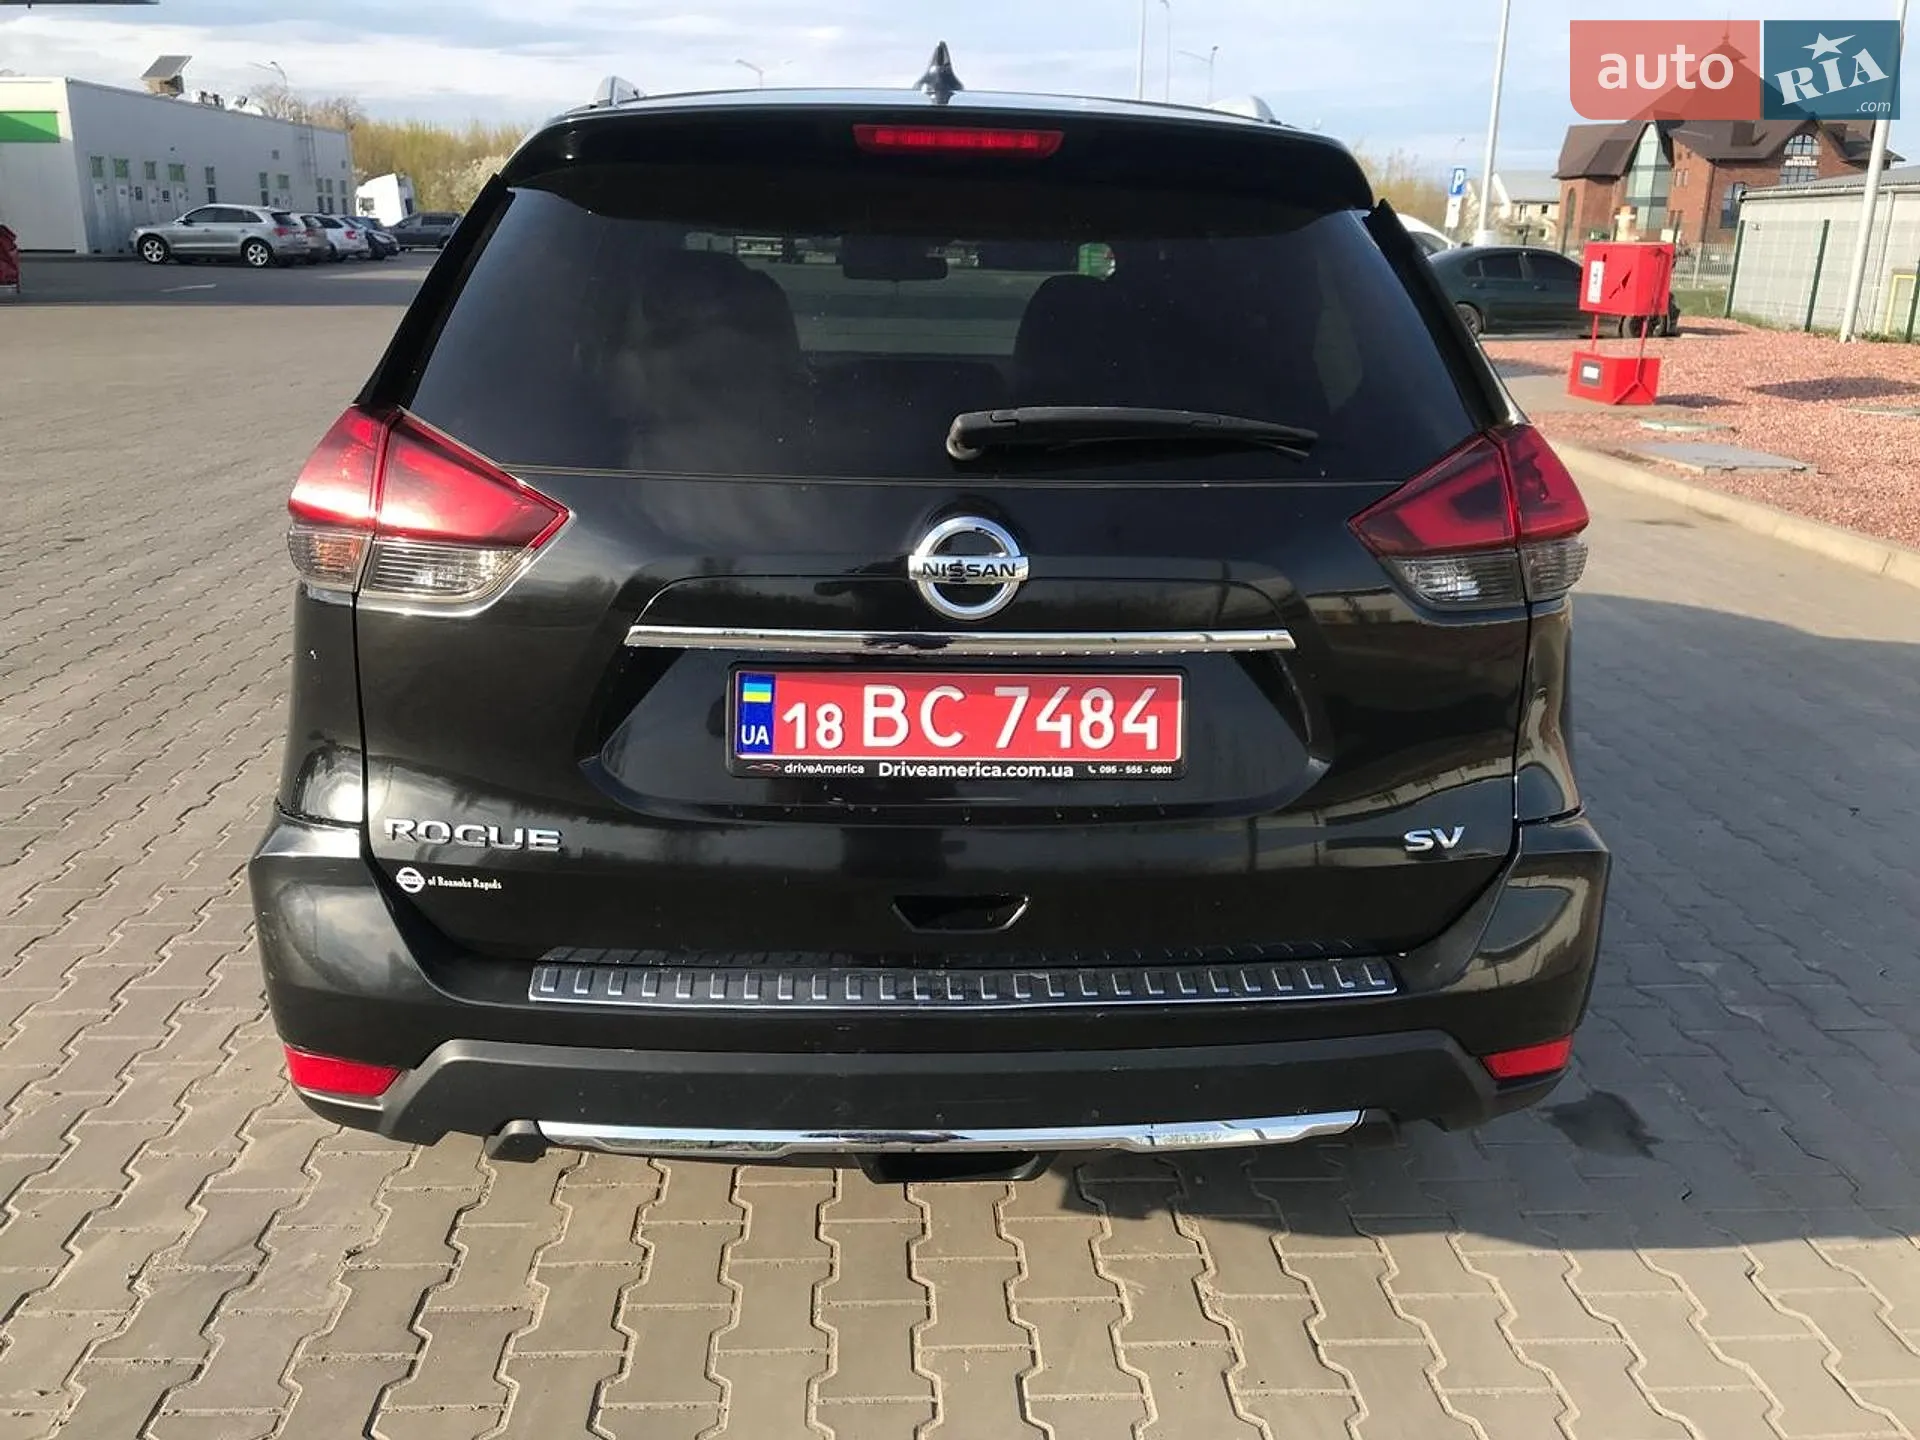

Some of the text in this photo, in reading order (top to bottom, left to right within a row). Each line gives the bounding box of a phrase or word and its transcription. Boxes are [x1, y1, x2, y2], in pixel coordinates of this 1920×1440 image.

[921, 561, 1017, 578] NISSAN
[782, 684, 1158, 751] 18 BC 7484
[741, 724, 770, 746] UA
[784, 762, 865, 775] driveAmerica
[878, 761, 1074, 777] Driveamerica.com.ua
[384, 818, 561, 852] ROGUE
[1404, 826, 1465, 852] SV
